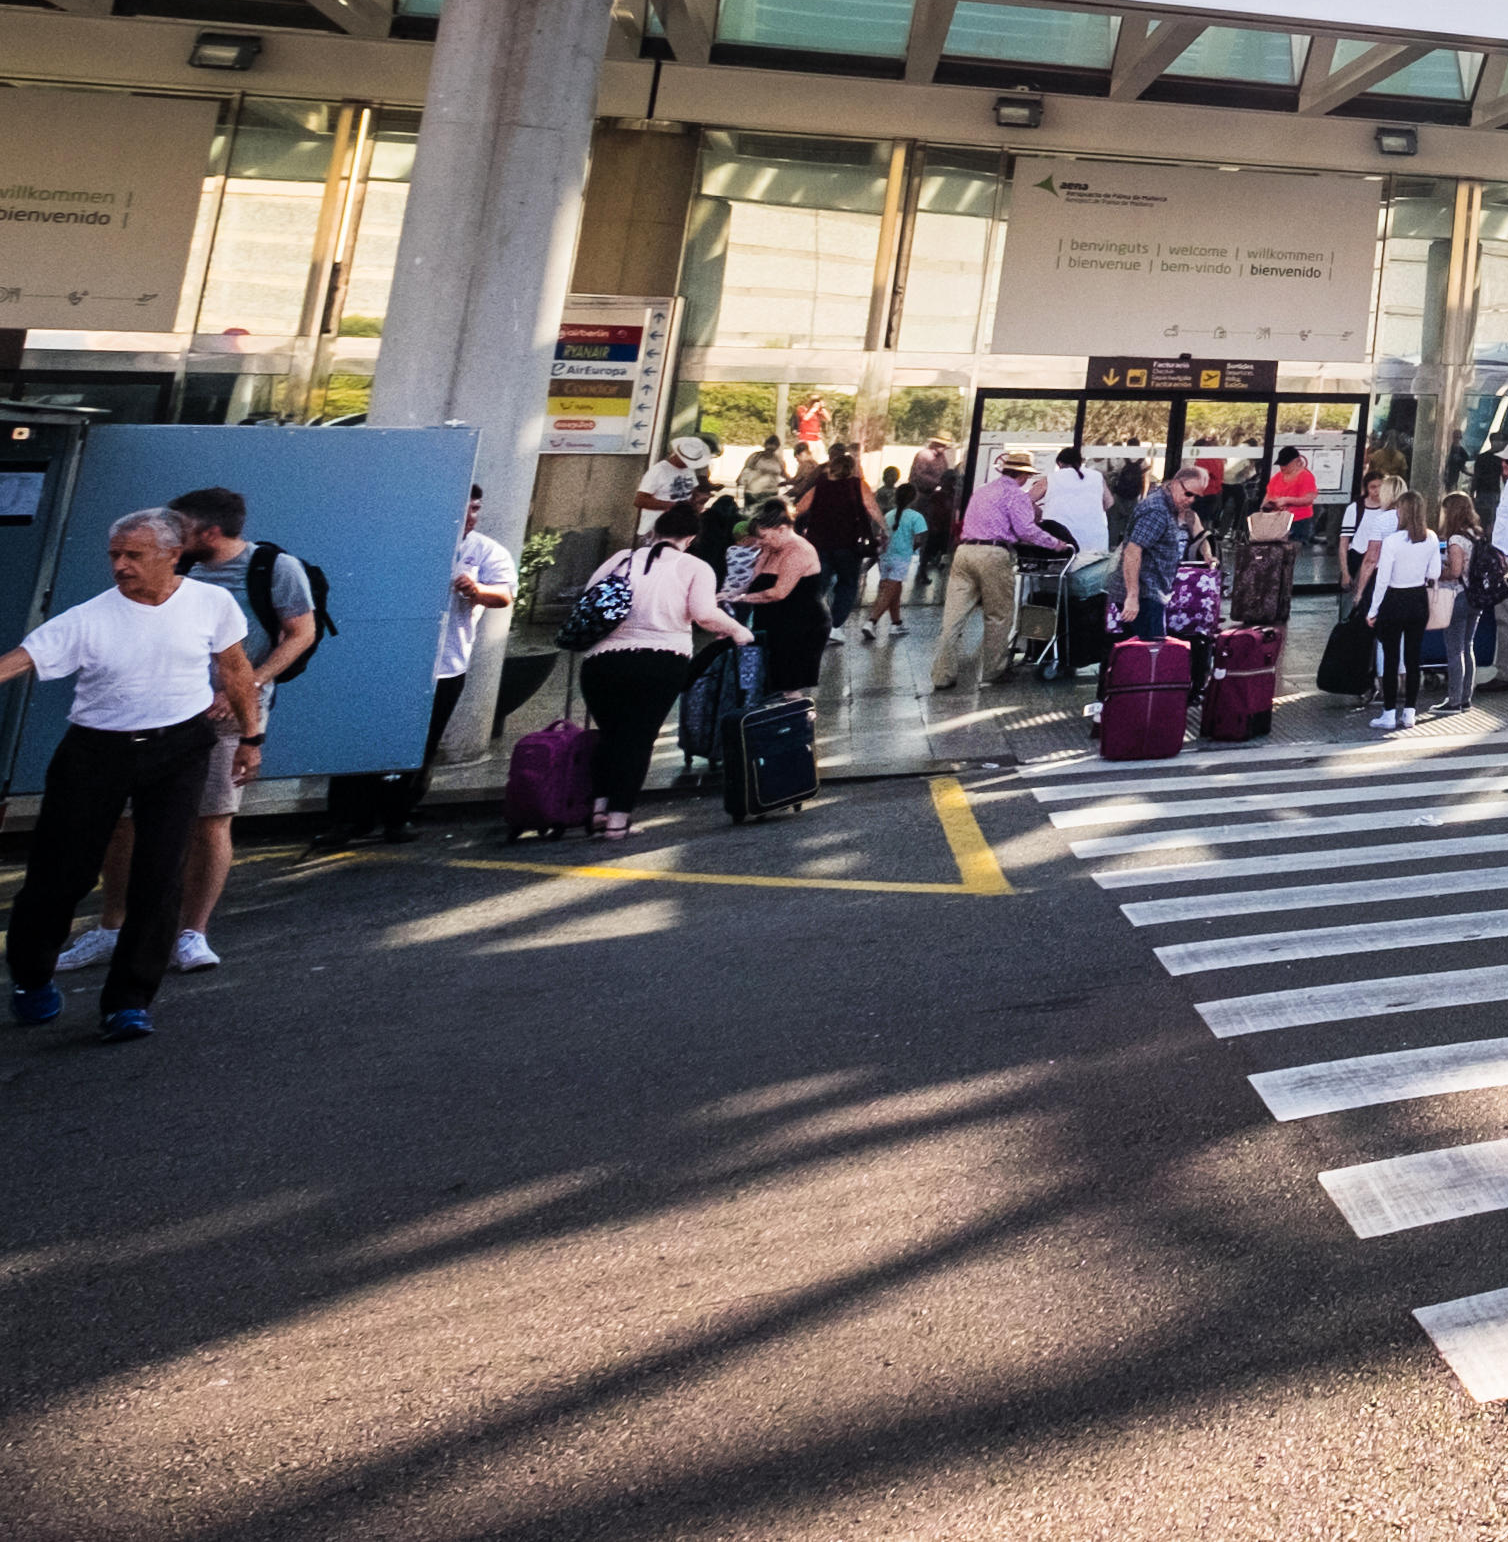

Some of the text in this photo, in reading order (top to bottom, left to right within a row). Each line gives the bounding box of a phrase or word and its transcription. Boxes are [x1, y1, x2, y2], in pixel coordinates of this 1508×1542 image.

[1070, 239, 1324, 262] benvinguts welcome willkommen
[1068, 256, 1322, 278] bienvenue bem-vindo bienvenido
[562, 345, 611, 359] RYANAIR
[566, 365, 628, 377] AirEuropa
